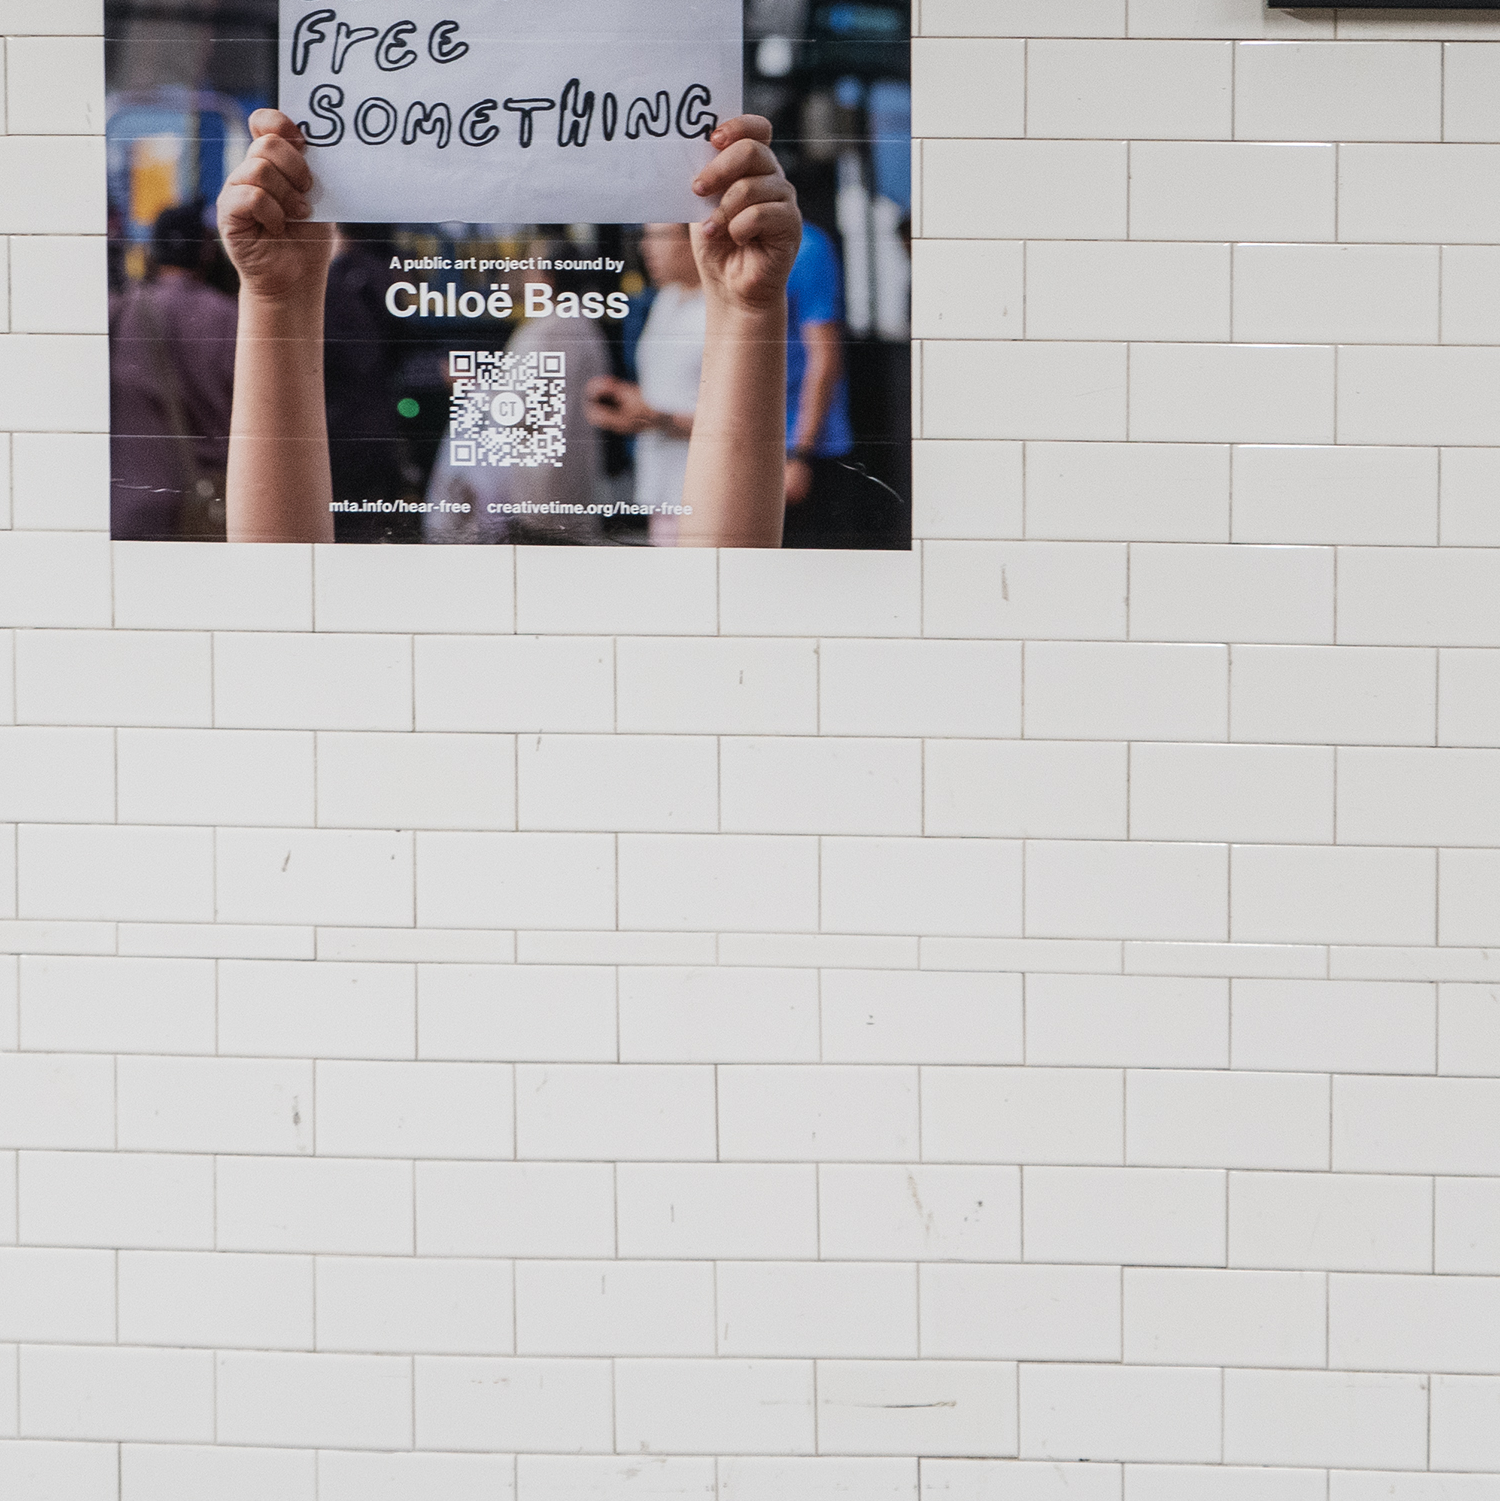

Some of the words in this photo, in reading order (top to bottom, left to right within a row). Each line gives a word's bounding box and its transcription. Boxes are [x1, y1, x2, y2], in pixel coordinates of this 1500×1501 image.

[297, 78, 718, 149] SOMETHING
[390, 257, 401, 269] A
[404, 257, 452, 271] public
[454, 257, 476, 269] art
[479, 257, 535, 272] project
[537, 257, 551, 270] in
[554, 257, 602, 270] sound
[606, 258, 624, 273] by
[386, 282, 513, 318] Chloë
[524, 282, 630, 319] Bass
[499, 401, 516, 416] CT
[329, 500, 471, 514] mta.info/hear-free
[487, 501, 692, 517] creativetime.org/hear-free
